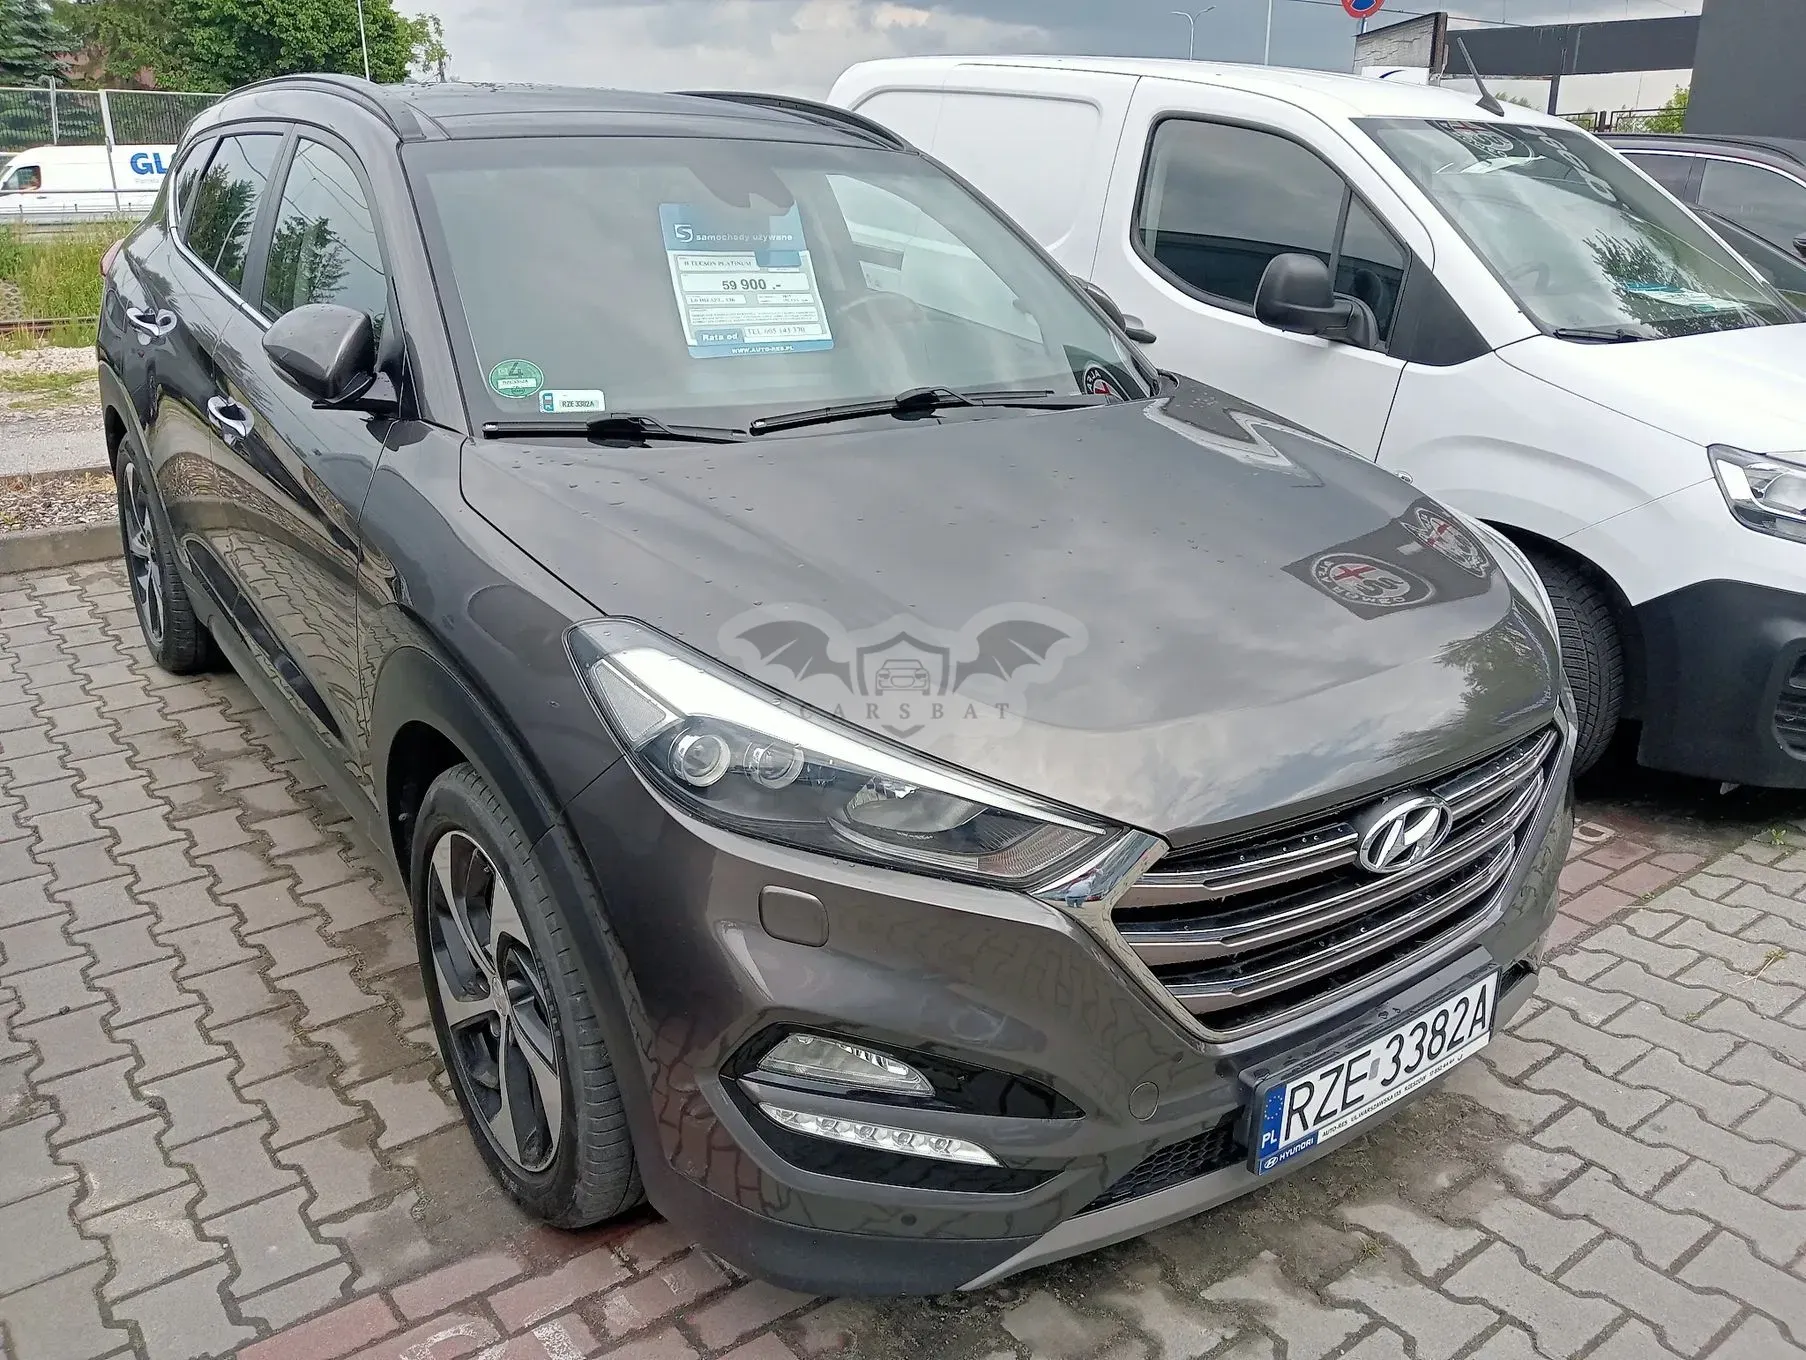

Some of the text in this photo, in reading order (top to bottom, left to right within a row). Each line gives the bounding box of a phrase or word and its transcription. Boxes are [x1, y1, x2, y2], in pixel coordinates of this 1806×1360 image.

[130, 152, 169, 175] GL
[696, 233, 749, 242] samochody
[722, 280, 737, 290] 59
[740, 278, 767, 290] 900
[702, 334, 725, 342] Rata
[562, 400, 574, 408] RZE
[1284, 984, 1488, 1141] RZE 3382A
[1261, 1129, 1278, 1149] PL
[1279, 1137, 1314, 1161] HYUNDAI
